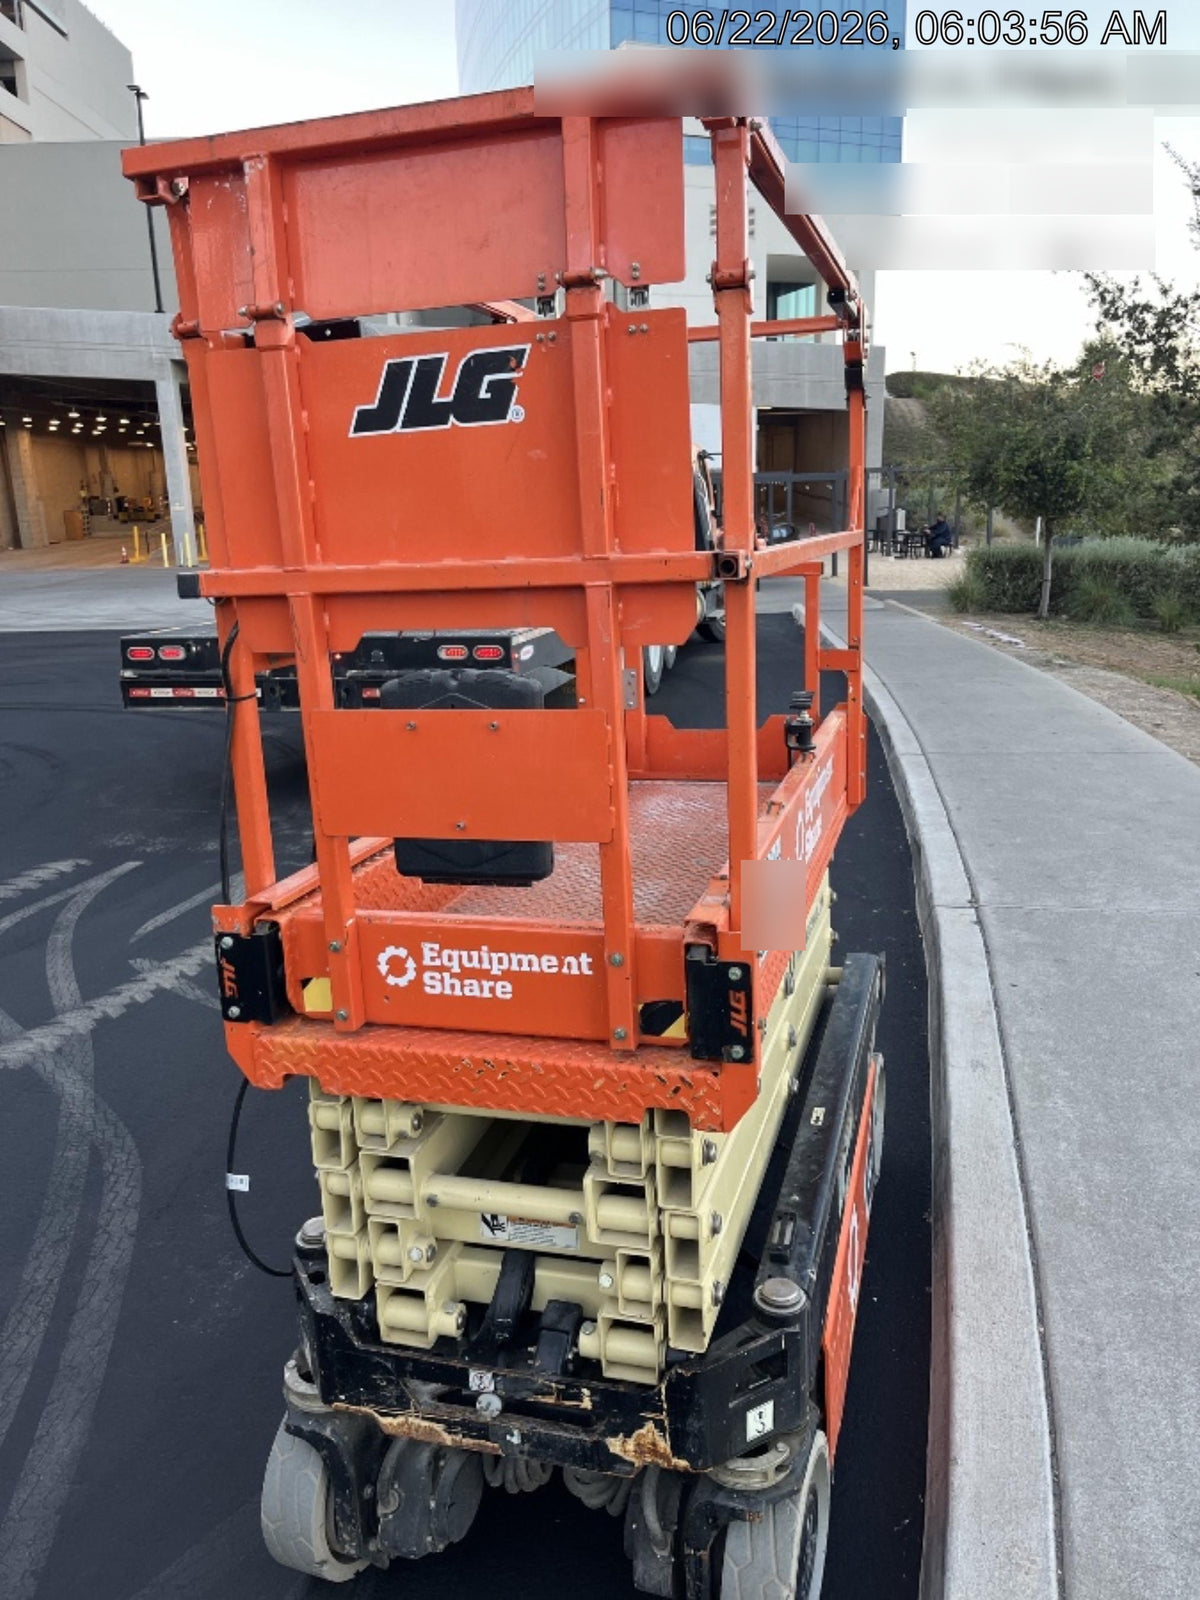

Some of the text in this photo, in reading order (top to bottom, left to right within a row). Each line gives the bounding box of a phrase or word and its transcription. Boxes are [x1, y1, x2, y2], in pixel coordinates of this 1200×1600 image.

[348, 343, 532, 437] JLG
[221, 957, 239, 998] JLG
[421, 942, 593, 975] Equipment
[422, 971, 513, 1000] Share
[729, 989, 748, 1037] JLG
